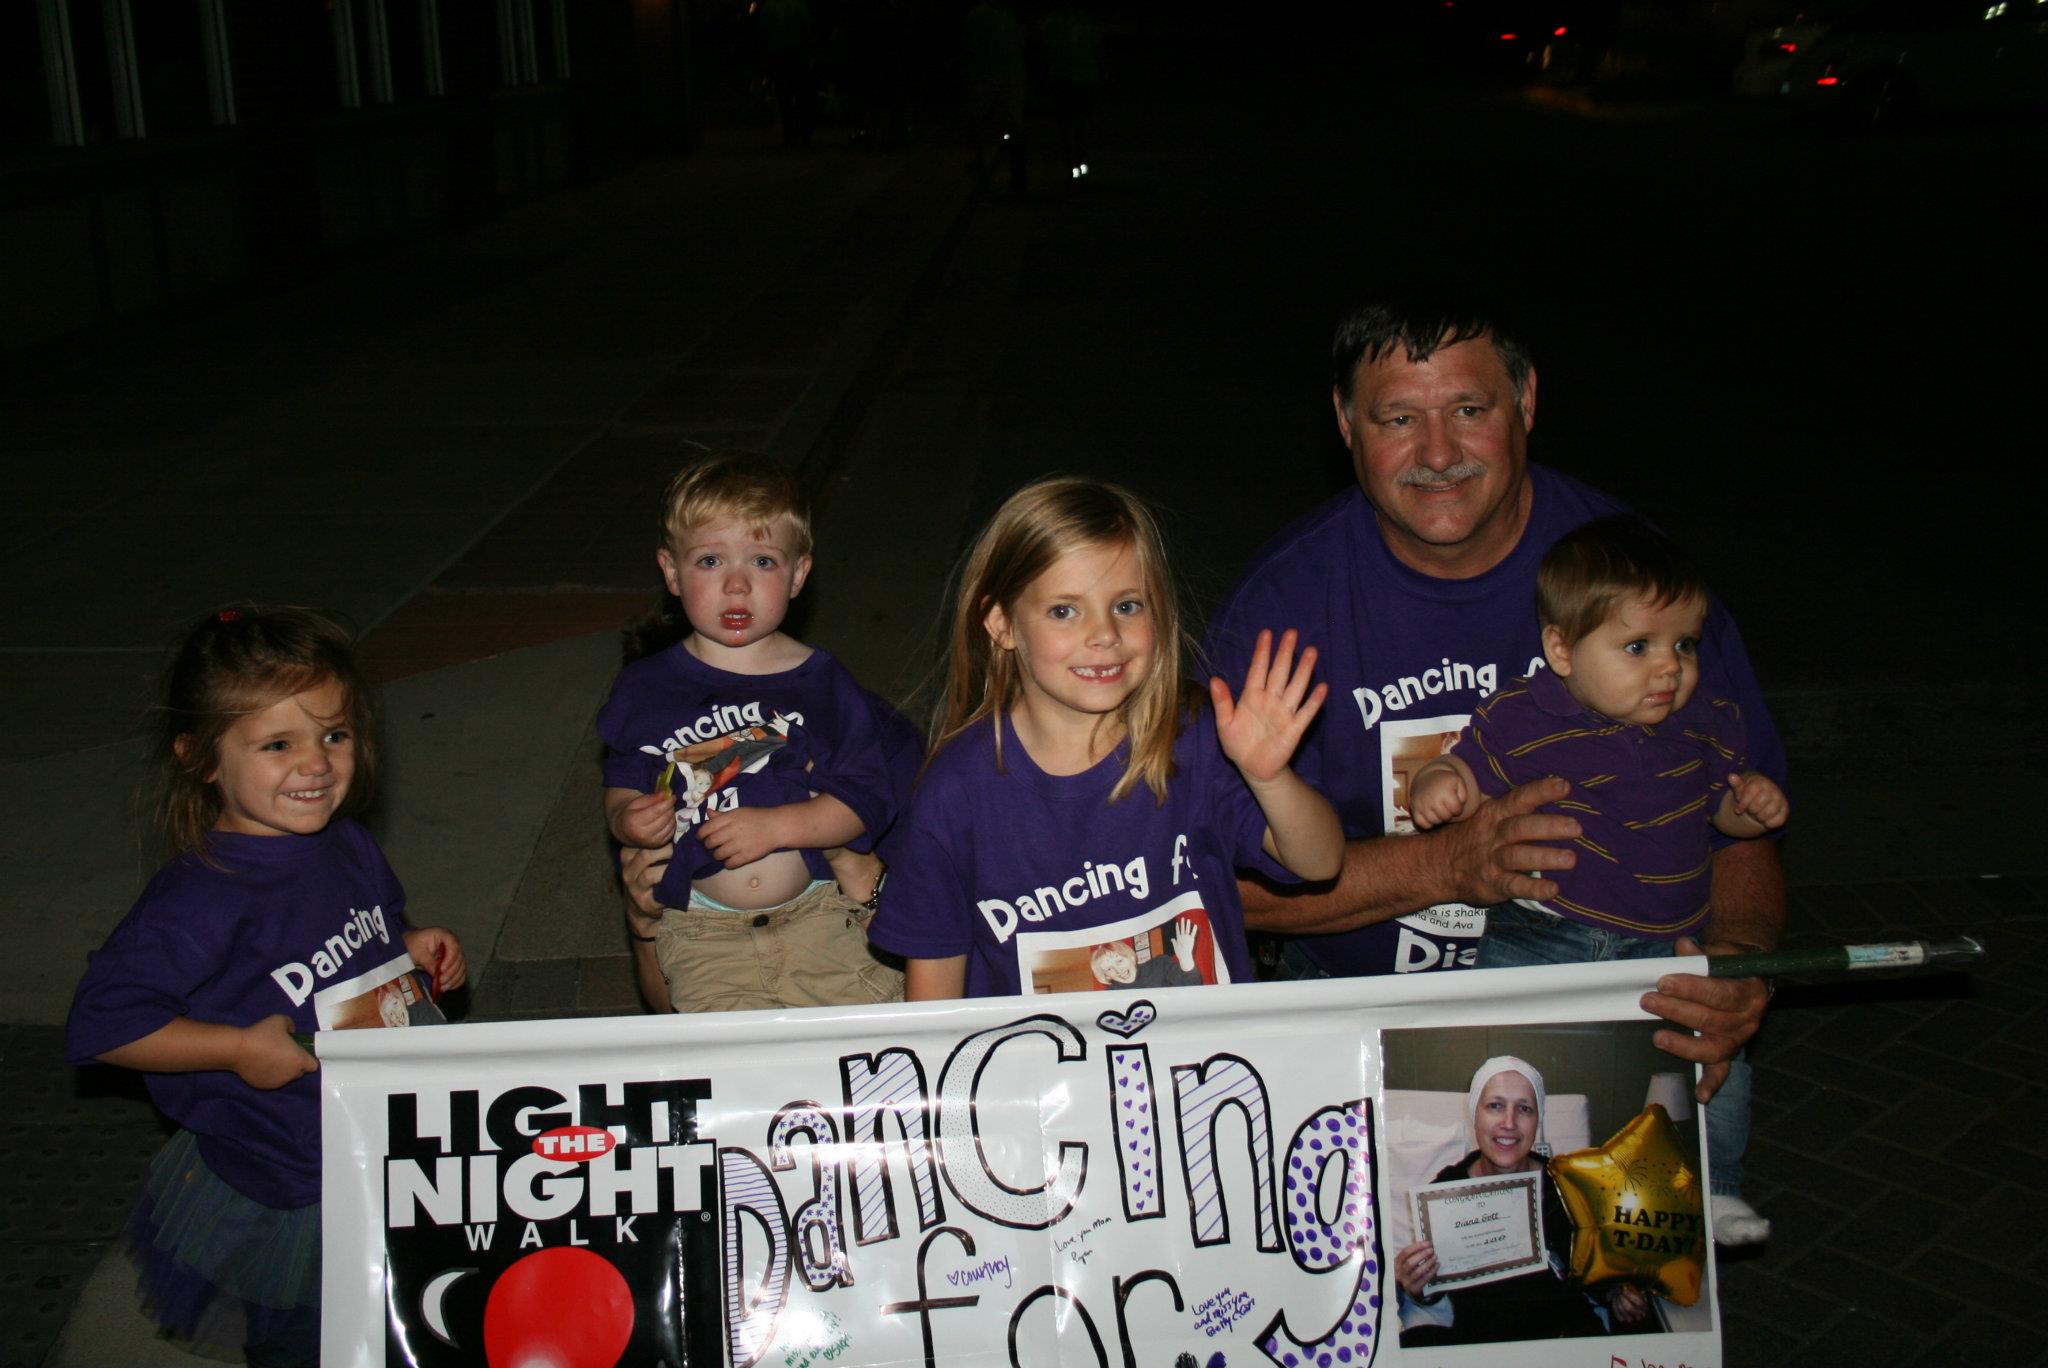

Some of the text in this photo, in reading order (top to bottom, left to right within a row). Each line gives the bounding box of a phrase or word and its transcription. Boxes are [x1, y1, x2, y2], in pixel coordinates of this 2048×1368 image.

[1352, 657, 1497, 731] Dancing
[976, 856, 1150, 944] Dancing
[1441, 907, 1451, 918] is
[1429, 917, 1474, 930] and Ava
[270, 905, 390, 1007] Dancing
[387, 1078, 712, 1153] LIGHT
[538, 1133, 606, 1155] THE
[388, 1143, 715, 1229] NIGHT
[466, 1215, 639, 1252] WALK
[1612, 1204, 1701, 1232] HAPPY
[879, 1226, 1185, 1368] for
[1191, 1298, 1217, 1316] Love
[1193, 1311, 1213, 1330] and
